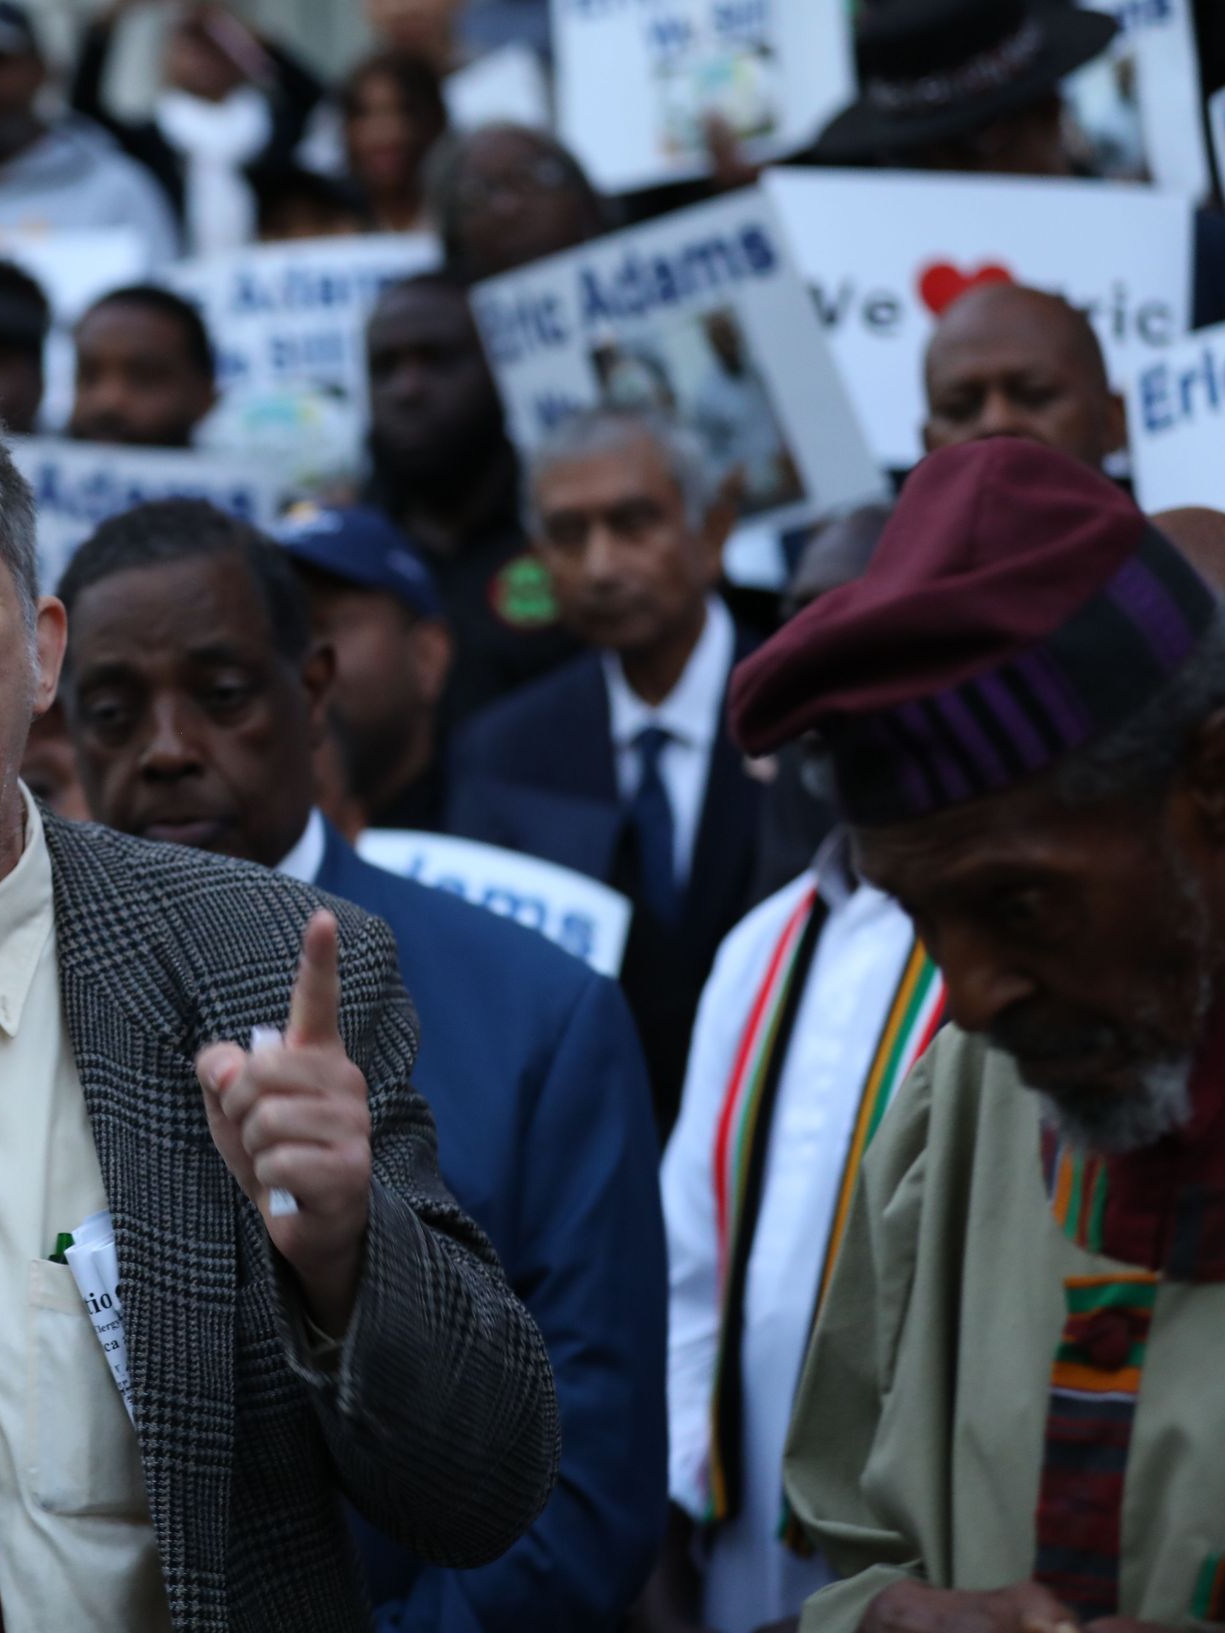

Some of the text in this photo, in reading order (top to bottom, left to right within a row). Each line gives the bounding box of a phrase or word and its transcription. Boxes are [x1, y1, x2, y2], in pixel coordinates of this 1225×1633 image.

[478, 222, 776, 363] Eric Adams
[1061, 280, 1176, 347] ric
[1139, 350, 1225, 438] Eri
